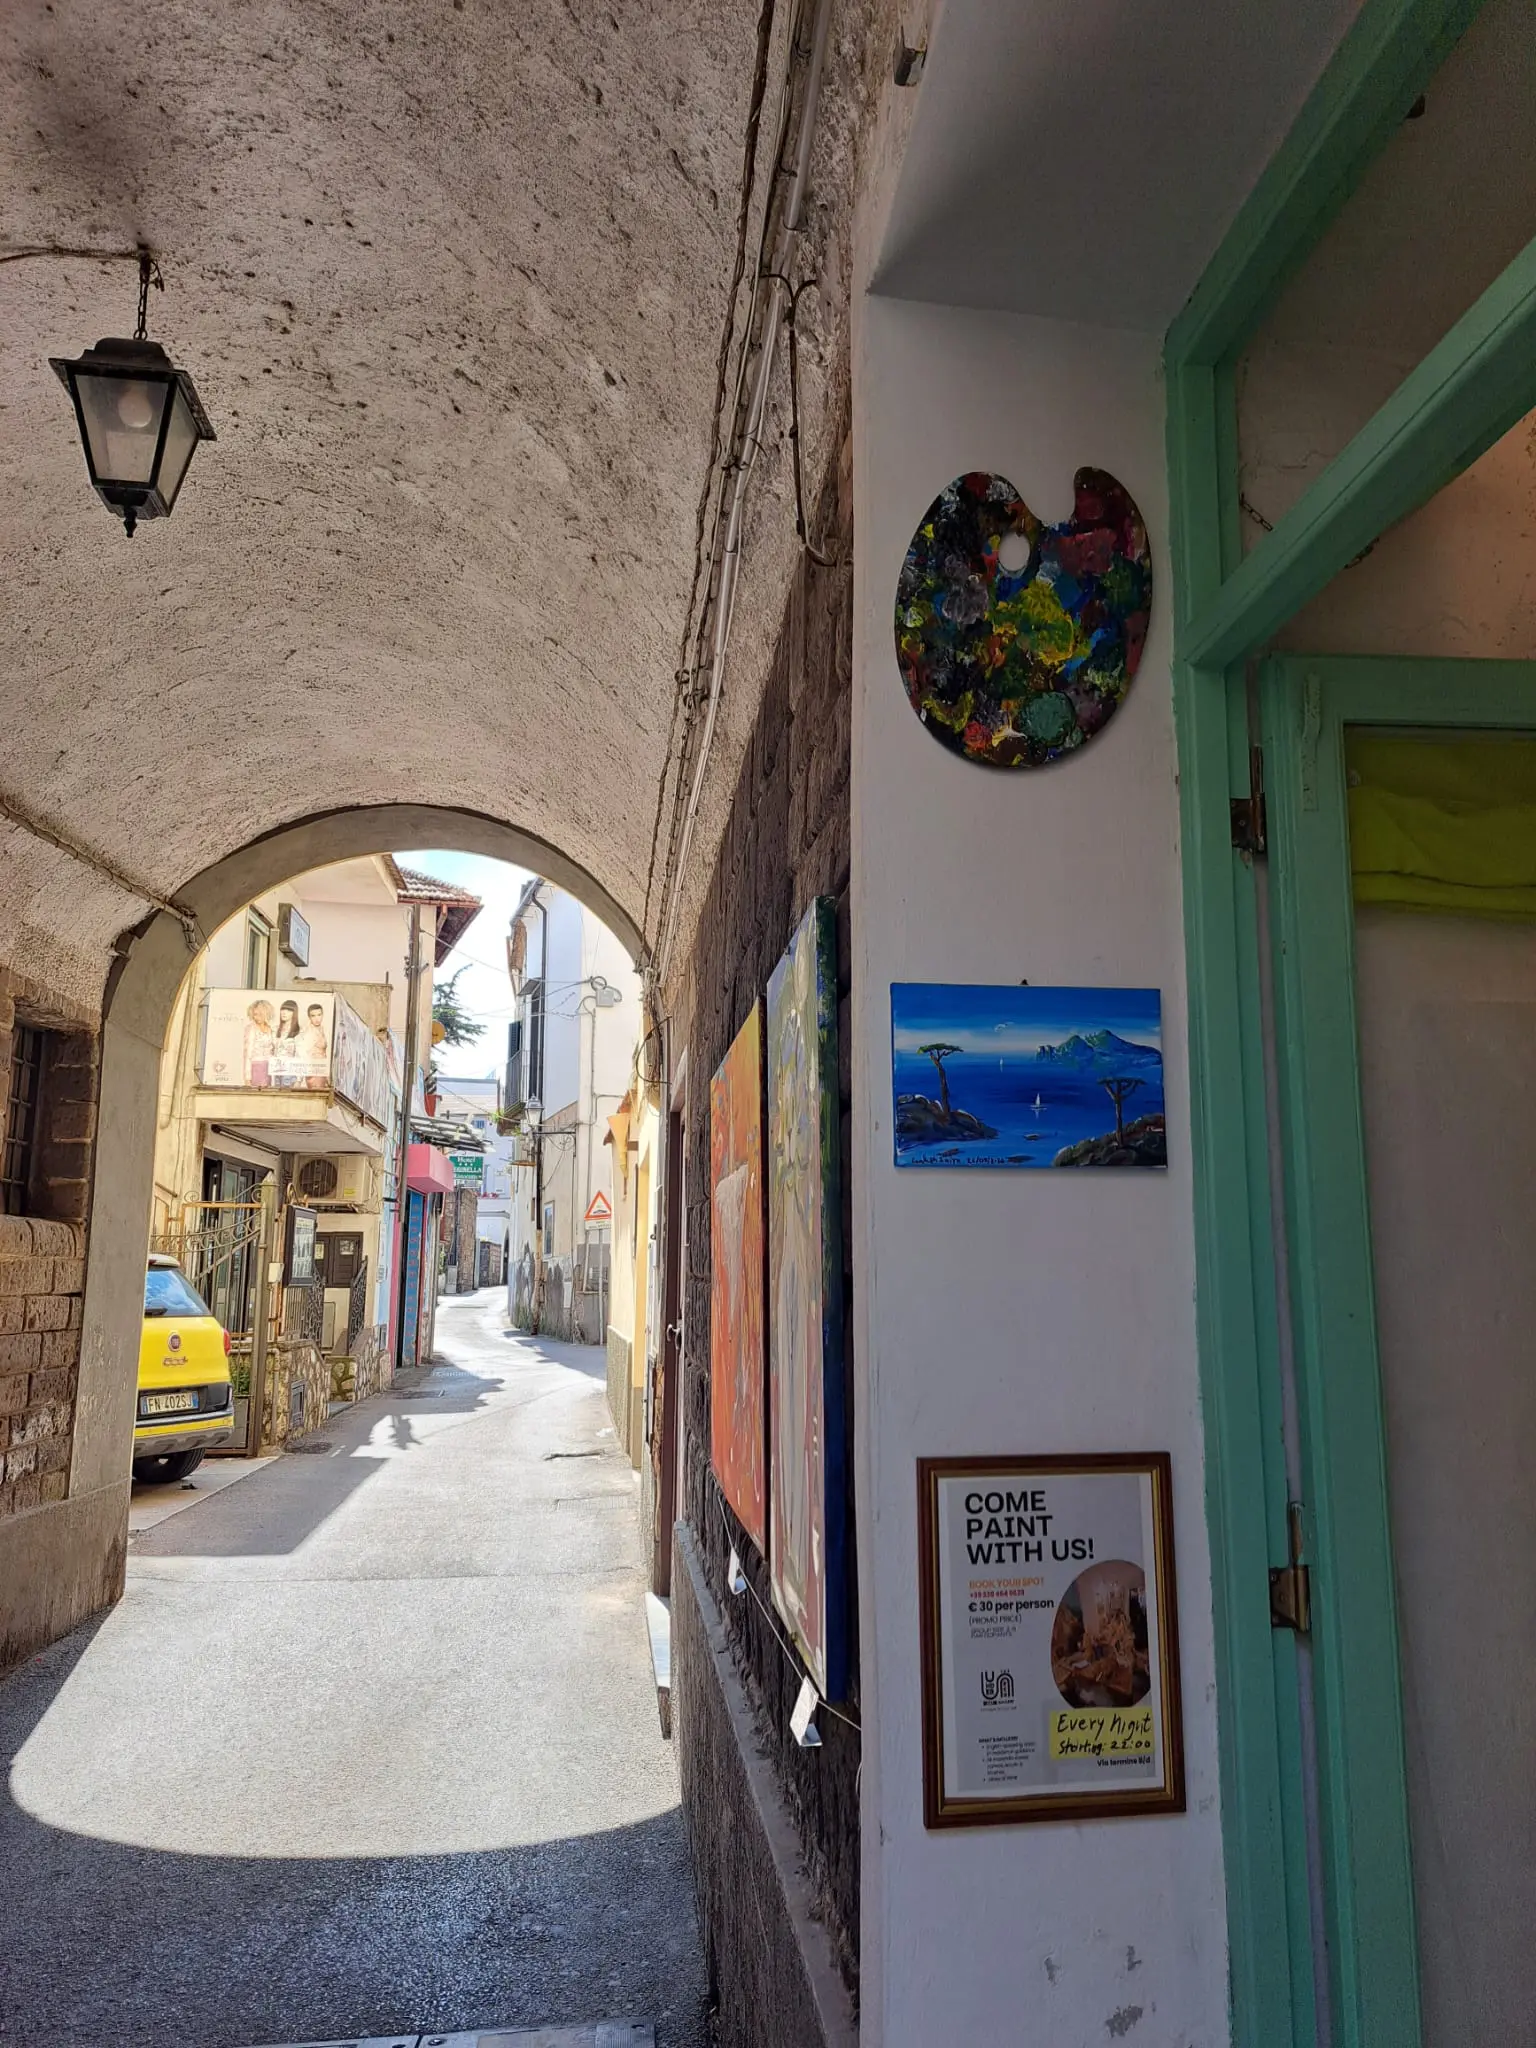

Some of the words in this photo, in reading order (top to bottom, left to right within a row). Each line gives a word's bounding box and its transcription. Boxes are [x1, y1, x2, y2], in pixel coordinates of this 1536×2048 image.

[147, 1396, 161, 1412] FN
[965, 1491, 1046, 1514] COME
[966, 1515, 1053, 1540] PAINT
[966, 1540, 1043, 1565] WITH
[1051, 1538, 1095, 1562] US!
[998, 1578, 1021, 1588] YOUR
[1022, 1577, 1044, 1587] SPOT
[968, 1602, 978, 1612] €
[979, 1601, 993, 1612] 30
[995, 1602, 1014, 1614] per
[1015, 1599, 1054, 1613] person
[1057, 1713, 1105, 1741] Every
[1110, 1740, 1151, 1751] 22:00
